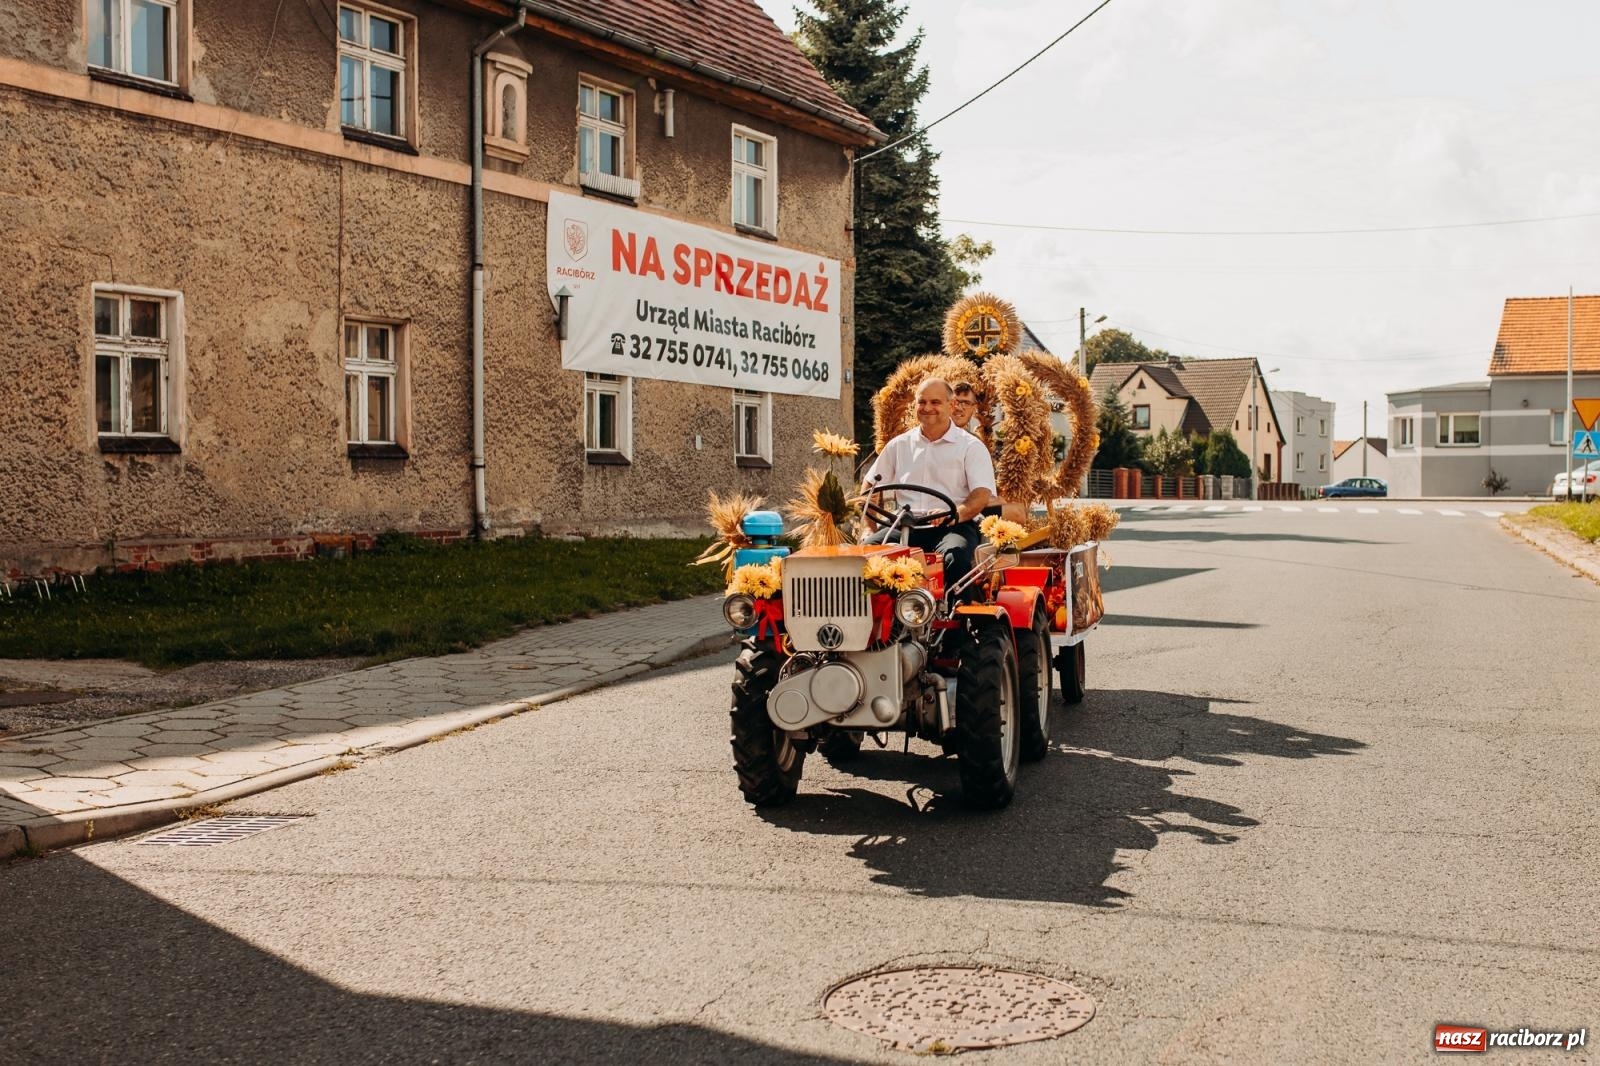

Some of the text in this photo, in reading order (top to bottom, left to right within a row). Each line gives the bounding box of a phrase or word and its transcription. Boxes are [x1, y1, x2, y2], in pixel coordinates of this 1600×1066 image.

[556, 266, 596, 280] RACIBÓRZ
[611, 228, 829, 313] NA SPRZEDAŻ
[636, 298, 816, 349] Urząd Miasta Racibórz
[629, 334, 829, 382] 32 755 0741, 32 755 0668
